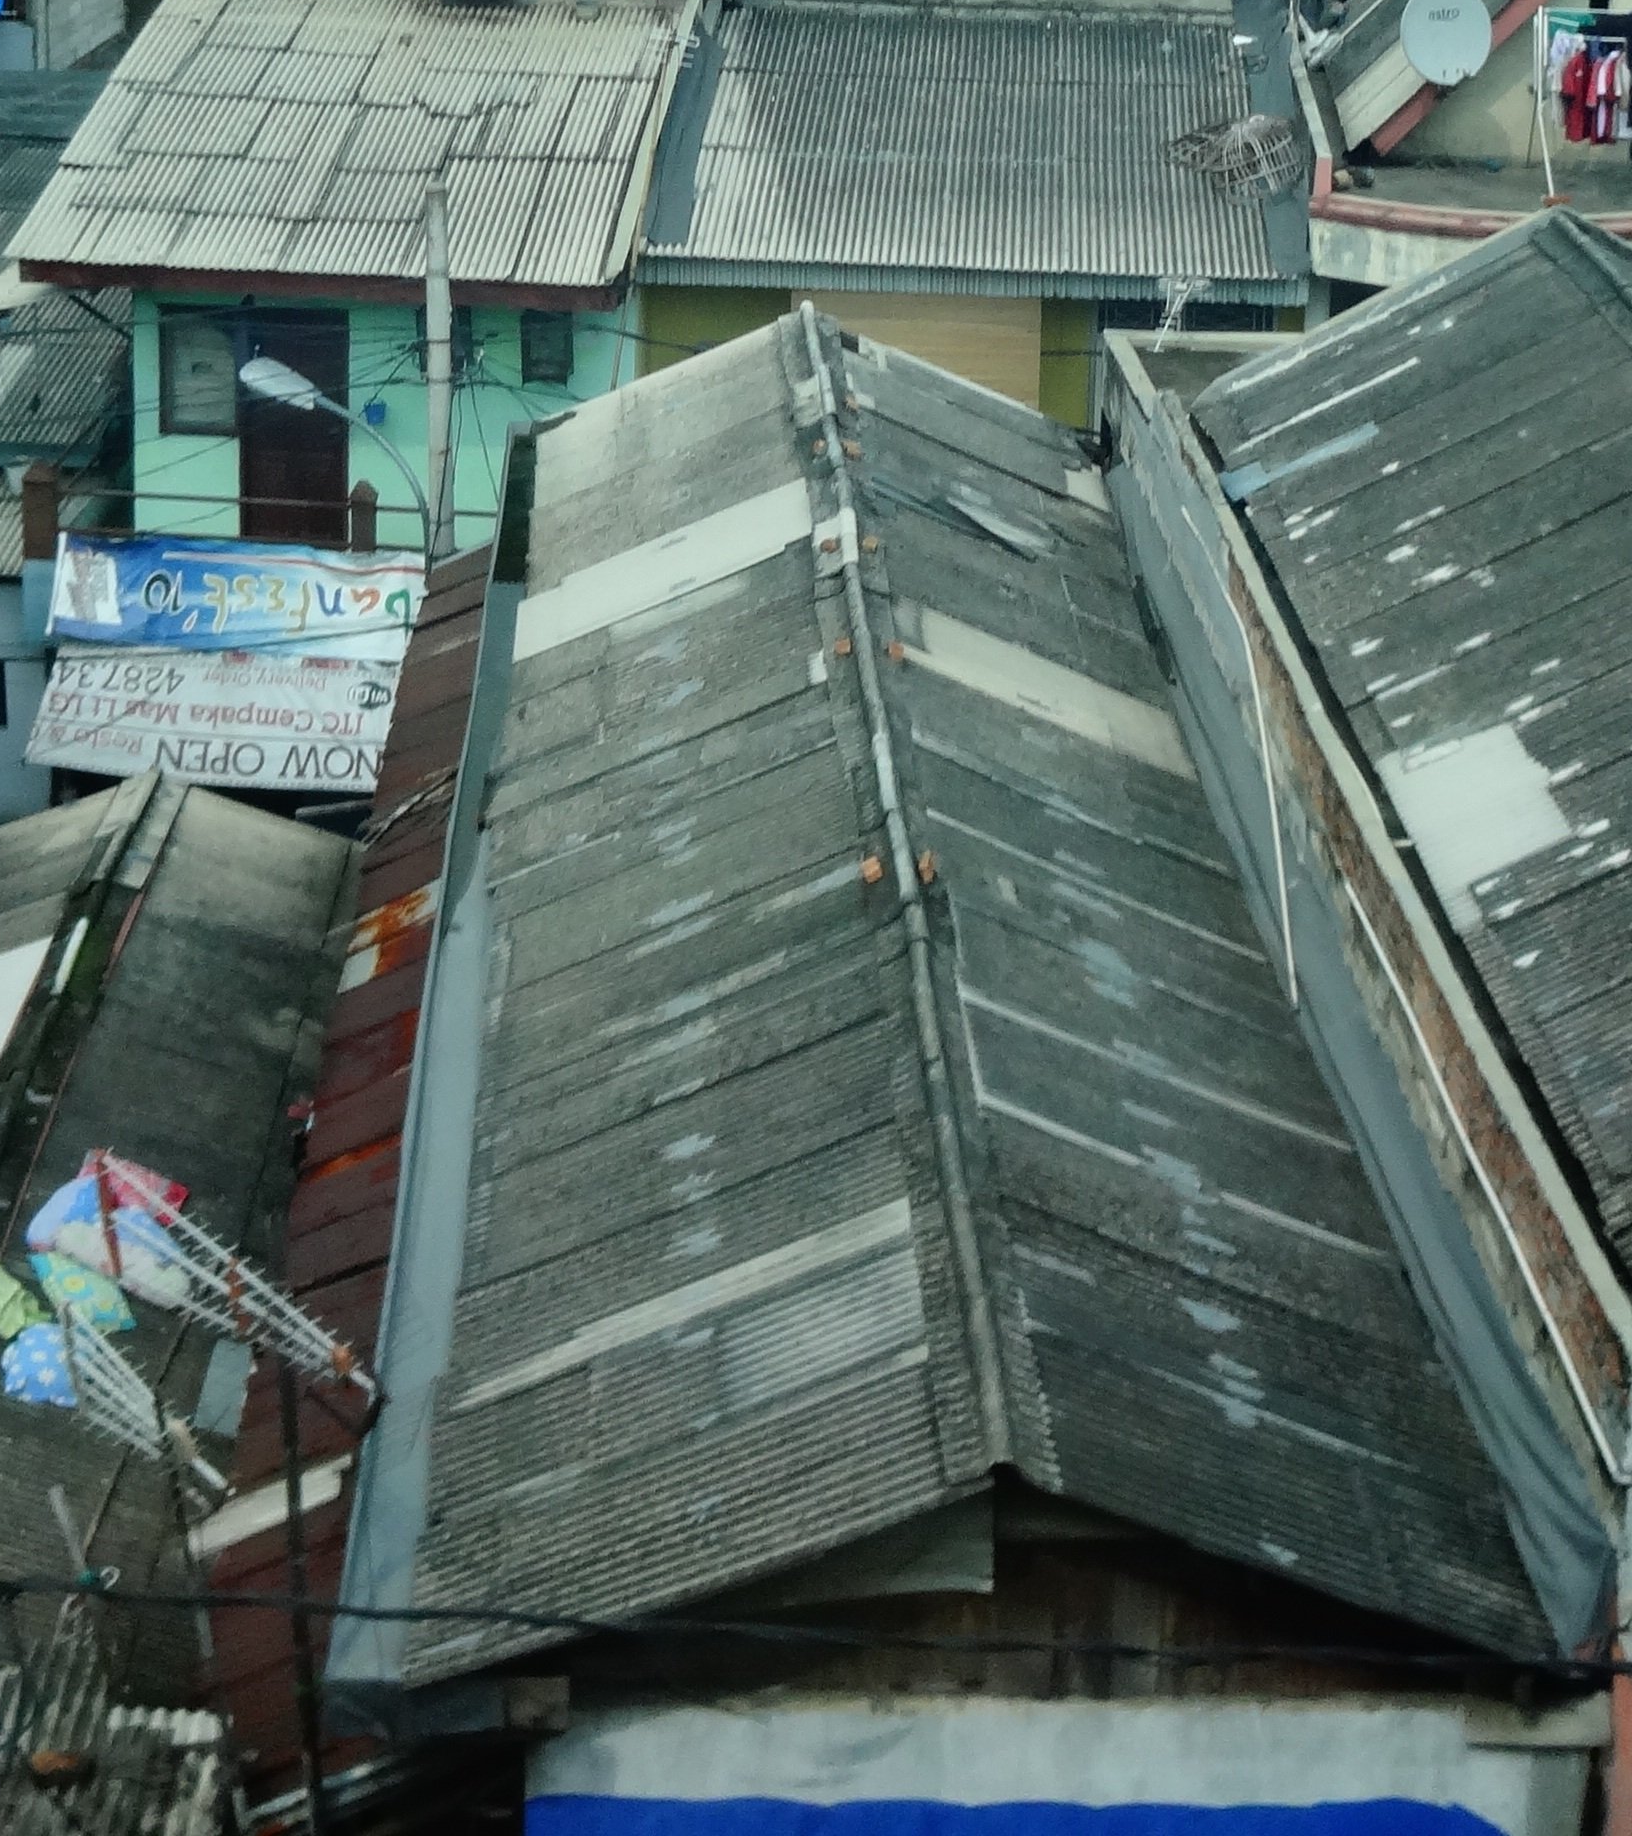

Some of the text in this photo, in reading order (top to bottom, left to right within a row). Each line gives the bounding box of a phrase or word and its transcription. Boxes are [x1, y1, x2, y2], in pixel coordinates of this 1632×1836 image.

[1429, 8, 1460, 21] astro
[189, 701, 314, 732] Cempaka
[320, 711, 365, 736] ITC
[154, 735, 266, 777] OPEN
[277, 743, 385, 781] NOW
